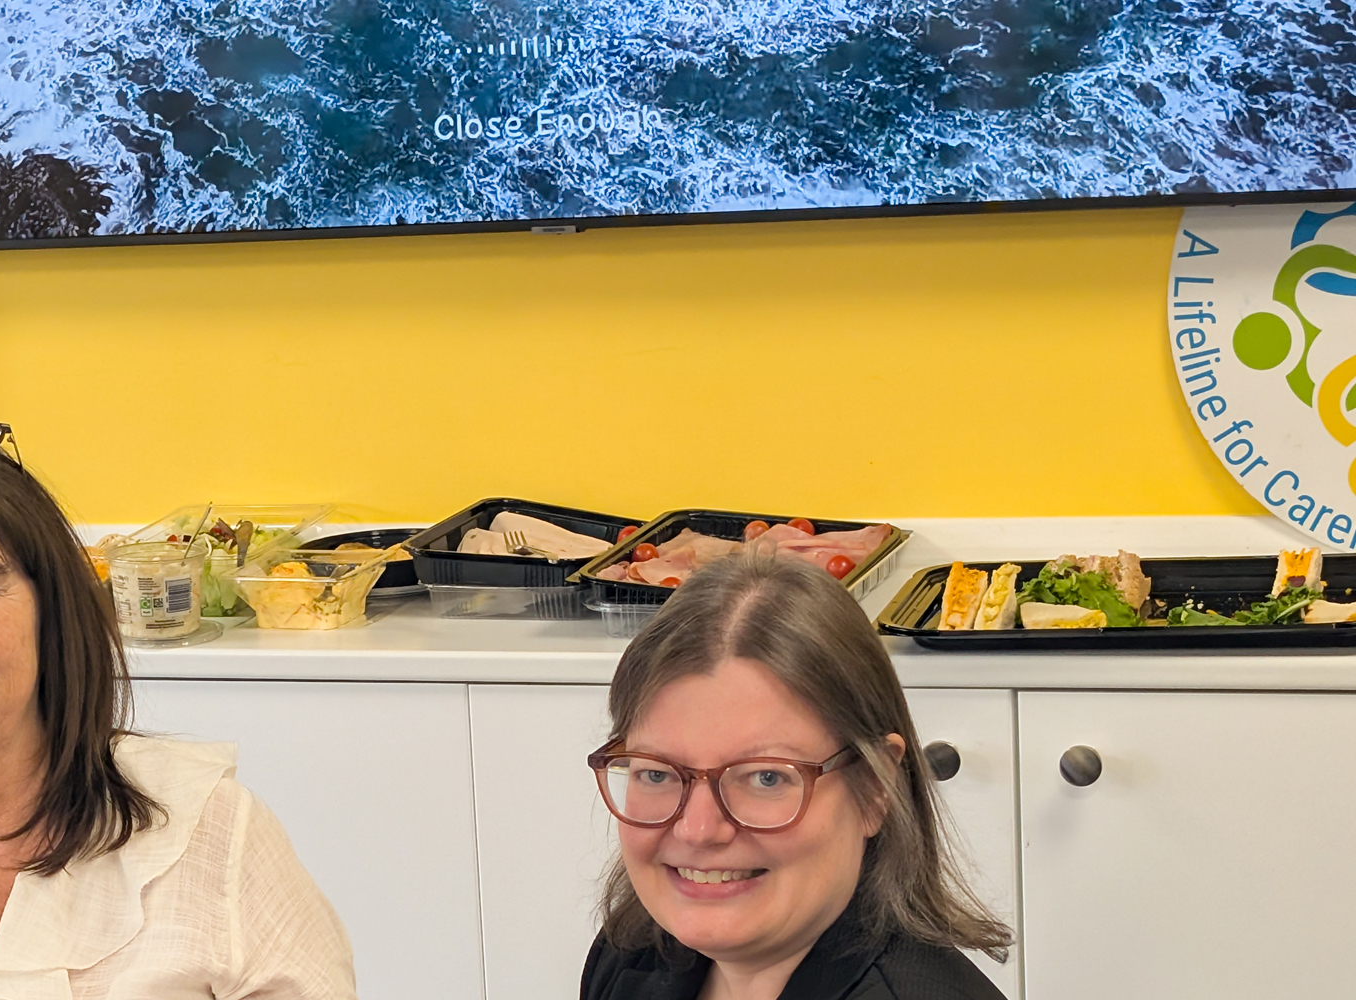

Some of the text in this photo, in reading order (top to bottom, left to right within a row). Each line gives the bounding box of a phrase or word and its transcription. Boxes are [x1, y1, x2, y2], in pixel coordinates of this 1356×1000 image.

[434, 104, 662, 140] Close Enough
[1173, 229, 1356, 549] A Lifeline for Care
